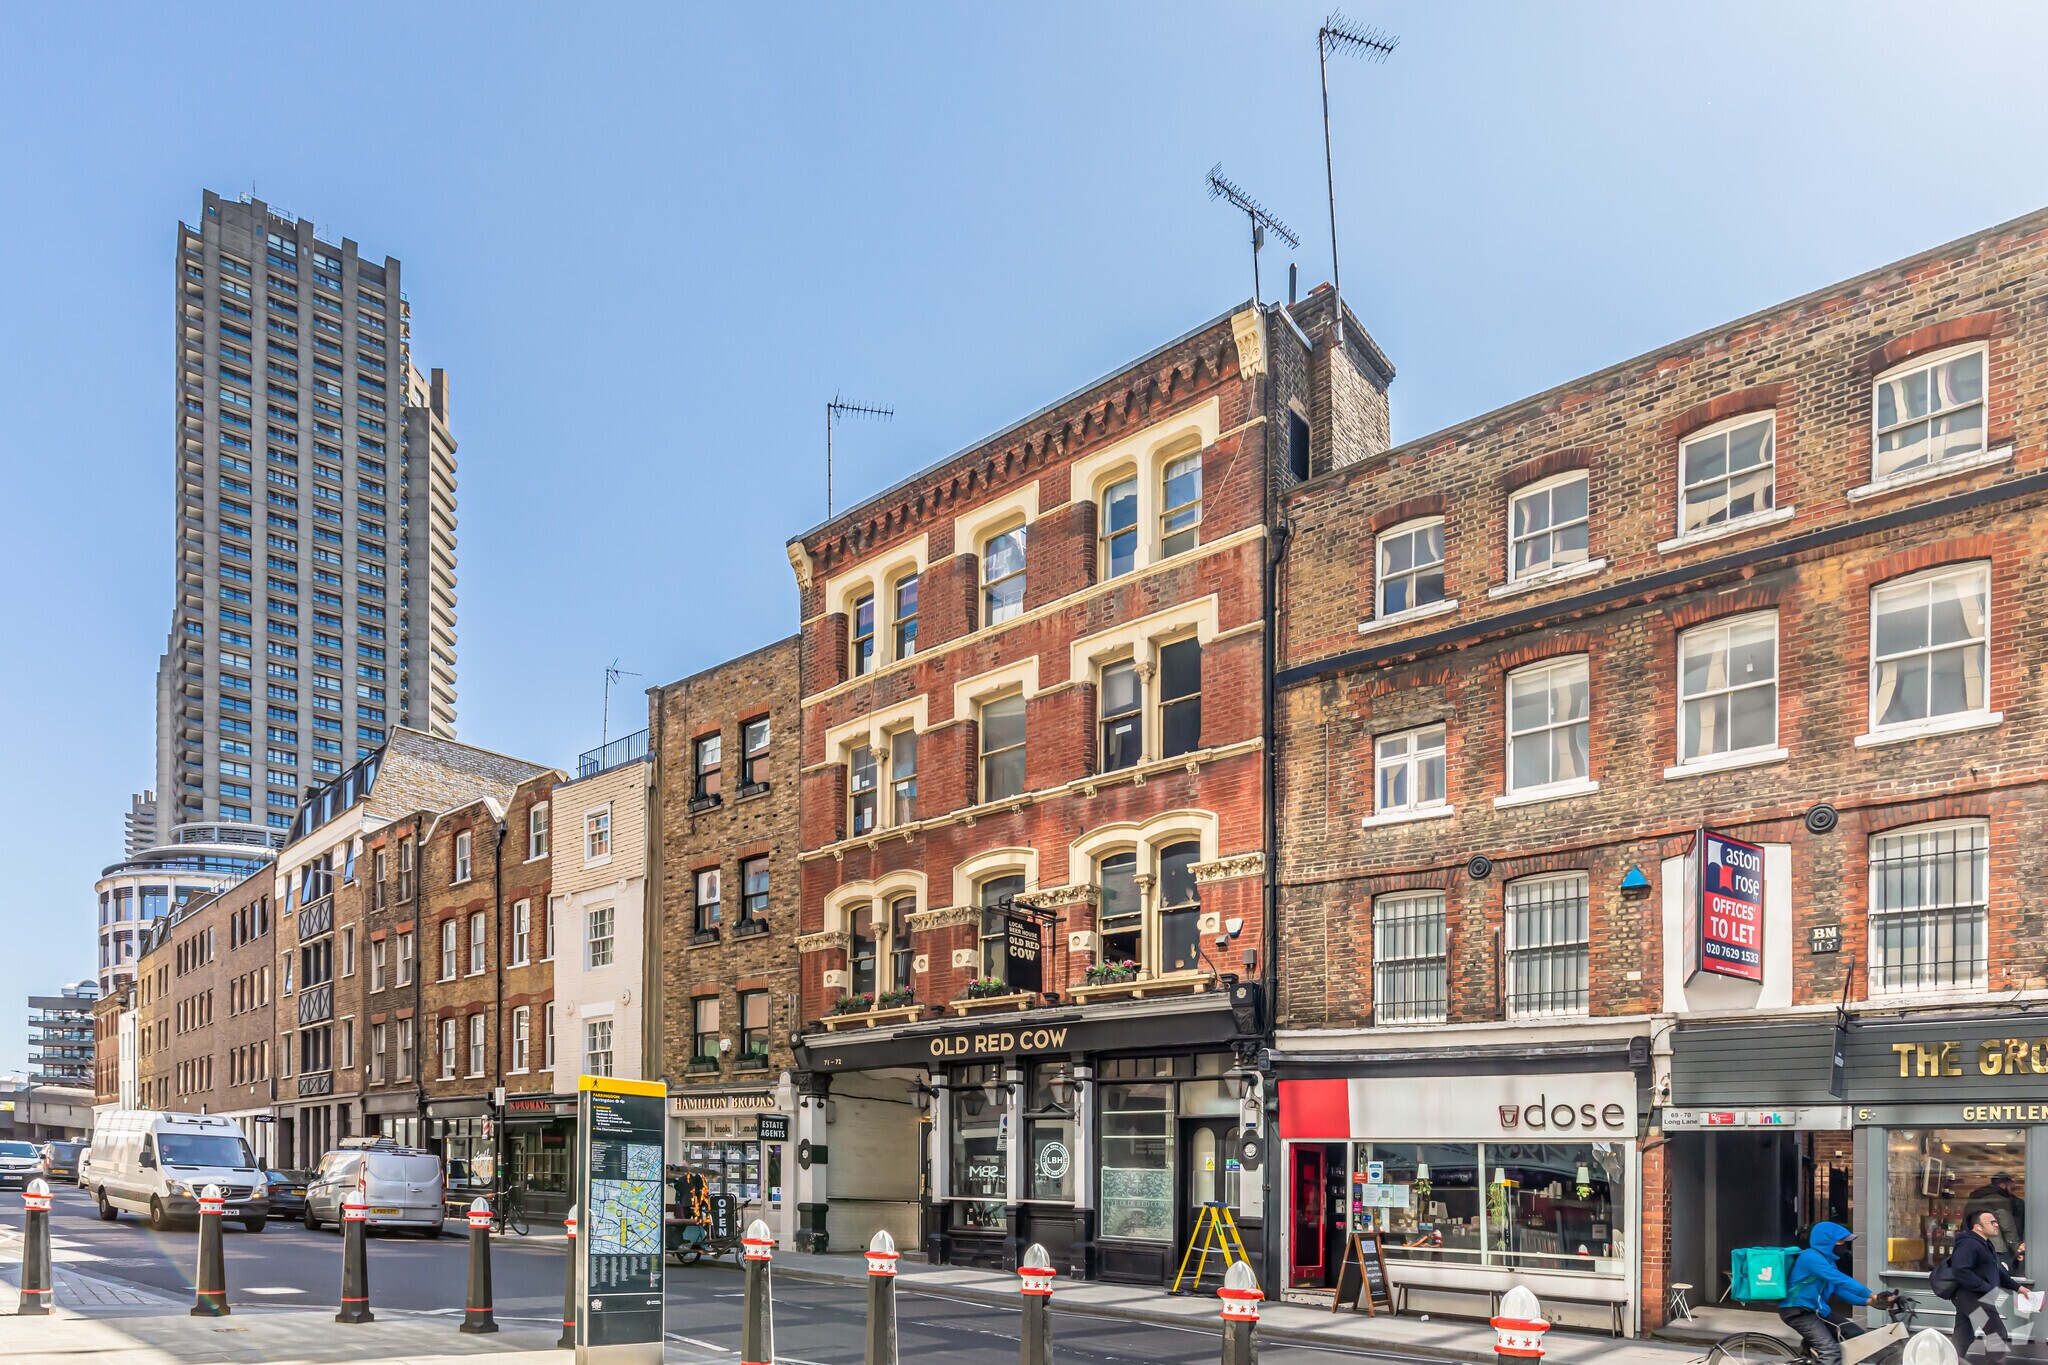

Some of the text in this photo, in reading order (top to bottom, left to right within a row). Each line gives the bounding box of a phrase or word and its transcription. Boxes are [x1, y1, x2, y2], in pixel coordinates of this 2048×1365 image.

[1725, 847, 1761, 873] aston
[1735, 873, 1760, 897] rose
[1712, 896, 1754, 921] OFFICES
[1008, 920, 1024, 930] LOCAL
[1008, 926, 1038, 939] BEER HOUSE
[1710, 916, 1756, 945] TO LET
[1813, 926, 1837, 940] BM
[1009, 936, 1040, 950] OLD RED
[1009, 945, 1036, 961] COW
[1706, 942, 1759, 964] 020 7629 1533
[930, 1027, 1068, 1057] OLD RED COW
[1892, 1041, 1962, 1078] THE
[675, 1094, 776, 1111] HAMILTON BROOKS
[1523, 1093, 1625, 1128] dose
[761, 1120, 784, 1130] ESTATE
[1759, 1112, 1782, 1124] ink
[714, 1124, 731, 1133] brooks
[760, 1128, 785, 1138] AGENTS
[1047, 1156, 1063, 1164] LBH
[1150, 1200, 1165, 1208] COW
[717, 1198, 727, 1237] OPEN
